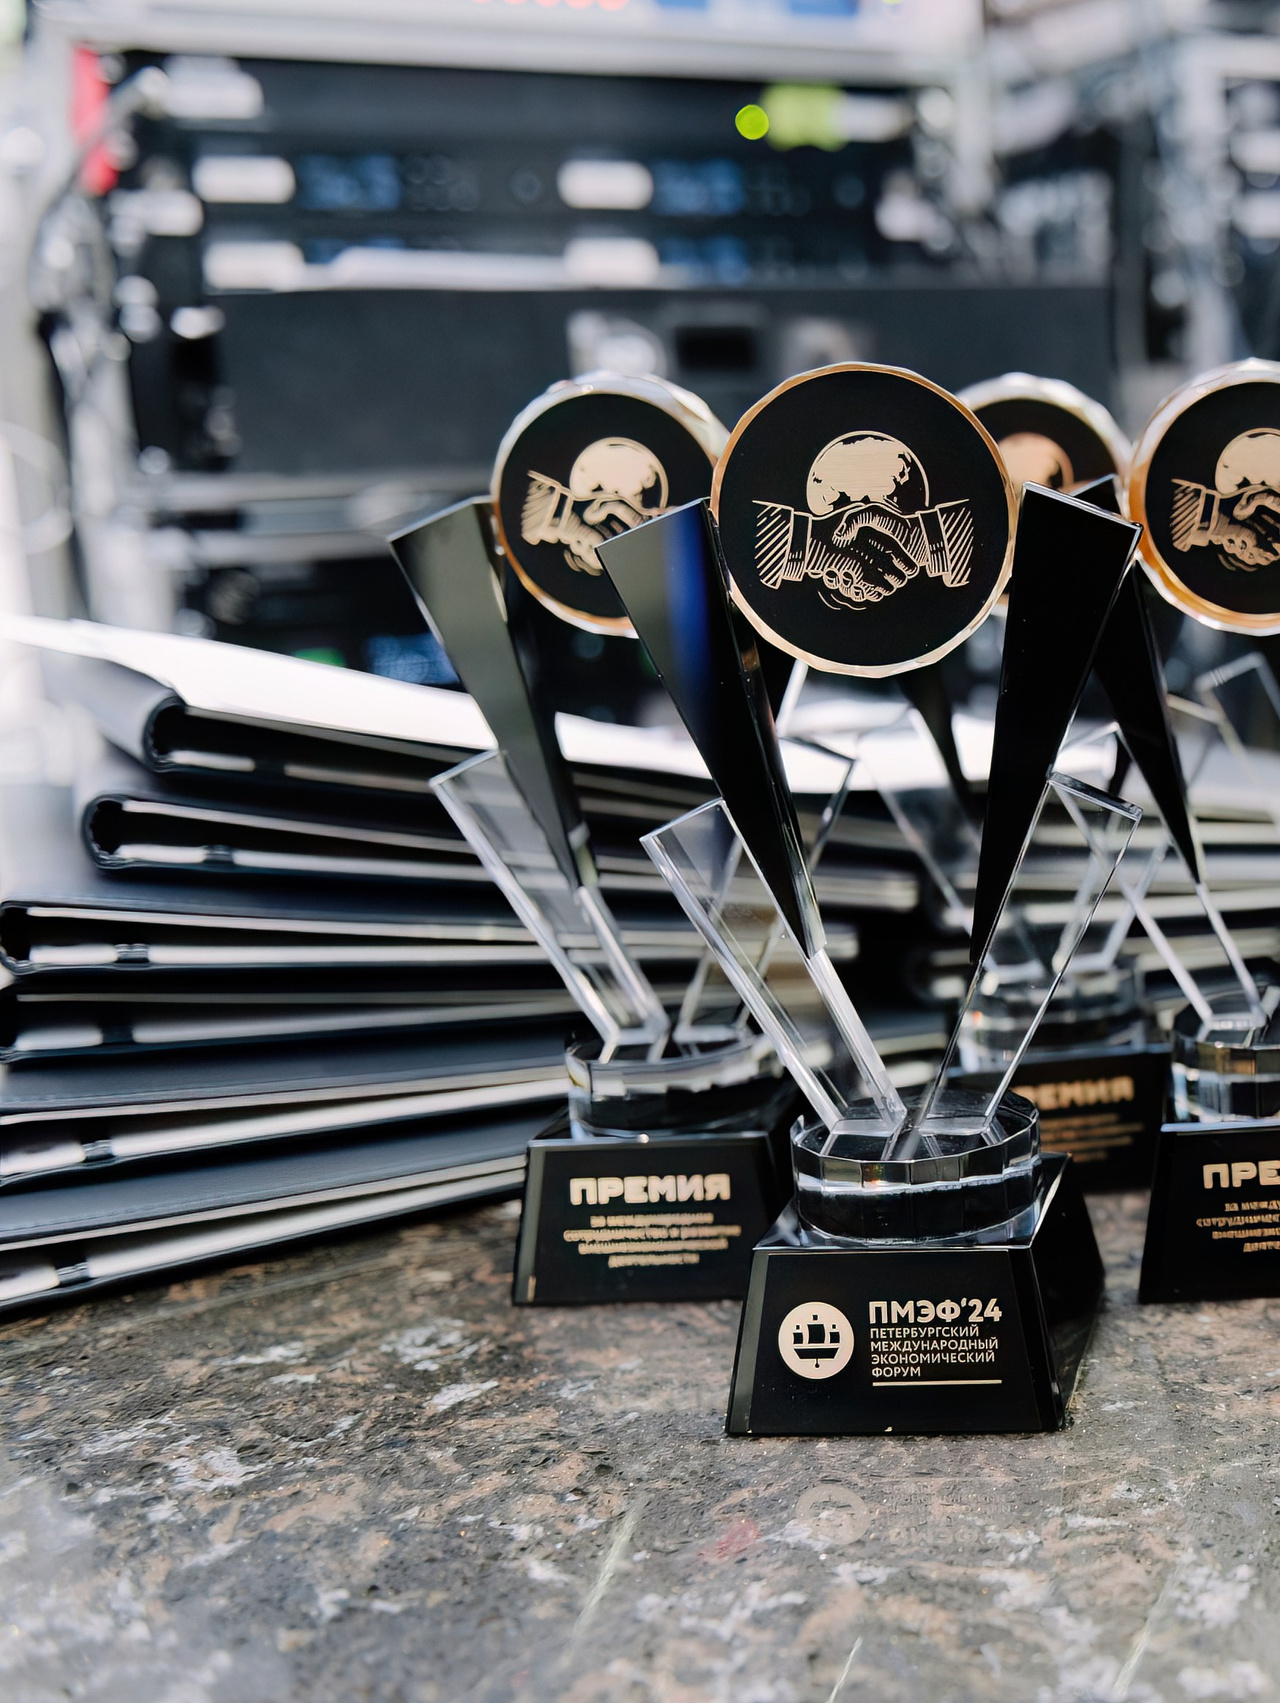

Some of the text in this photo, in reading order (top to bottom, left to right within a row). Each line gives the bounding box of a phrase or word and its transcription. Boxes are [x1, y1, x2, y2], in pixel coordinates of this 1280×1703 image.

[569, 1173, 731, 1206] ПРЕМИЯ
[868, 1297, 1003, 1324] ПМЭФ'24
[870, 1324, 979, 1339] ПЕТЕРБУРГСКИЙ
[870, 1337, 999, 1353] МЕЖДУНАРОДНЫЙ
[871, 1350, 995, 1365] ЭКОНОМИЧЕСКИЙ
[871, 1366, 921, 1378] ФОРУМ
